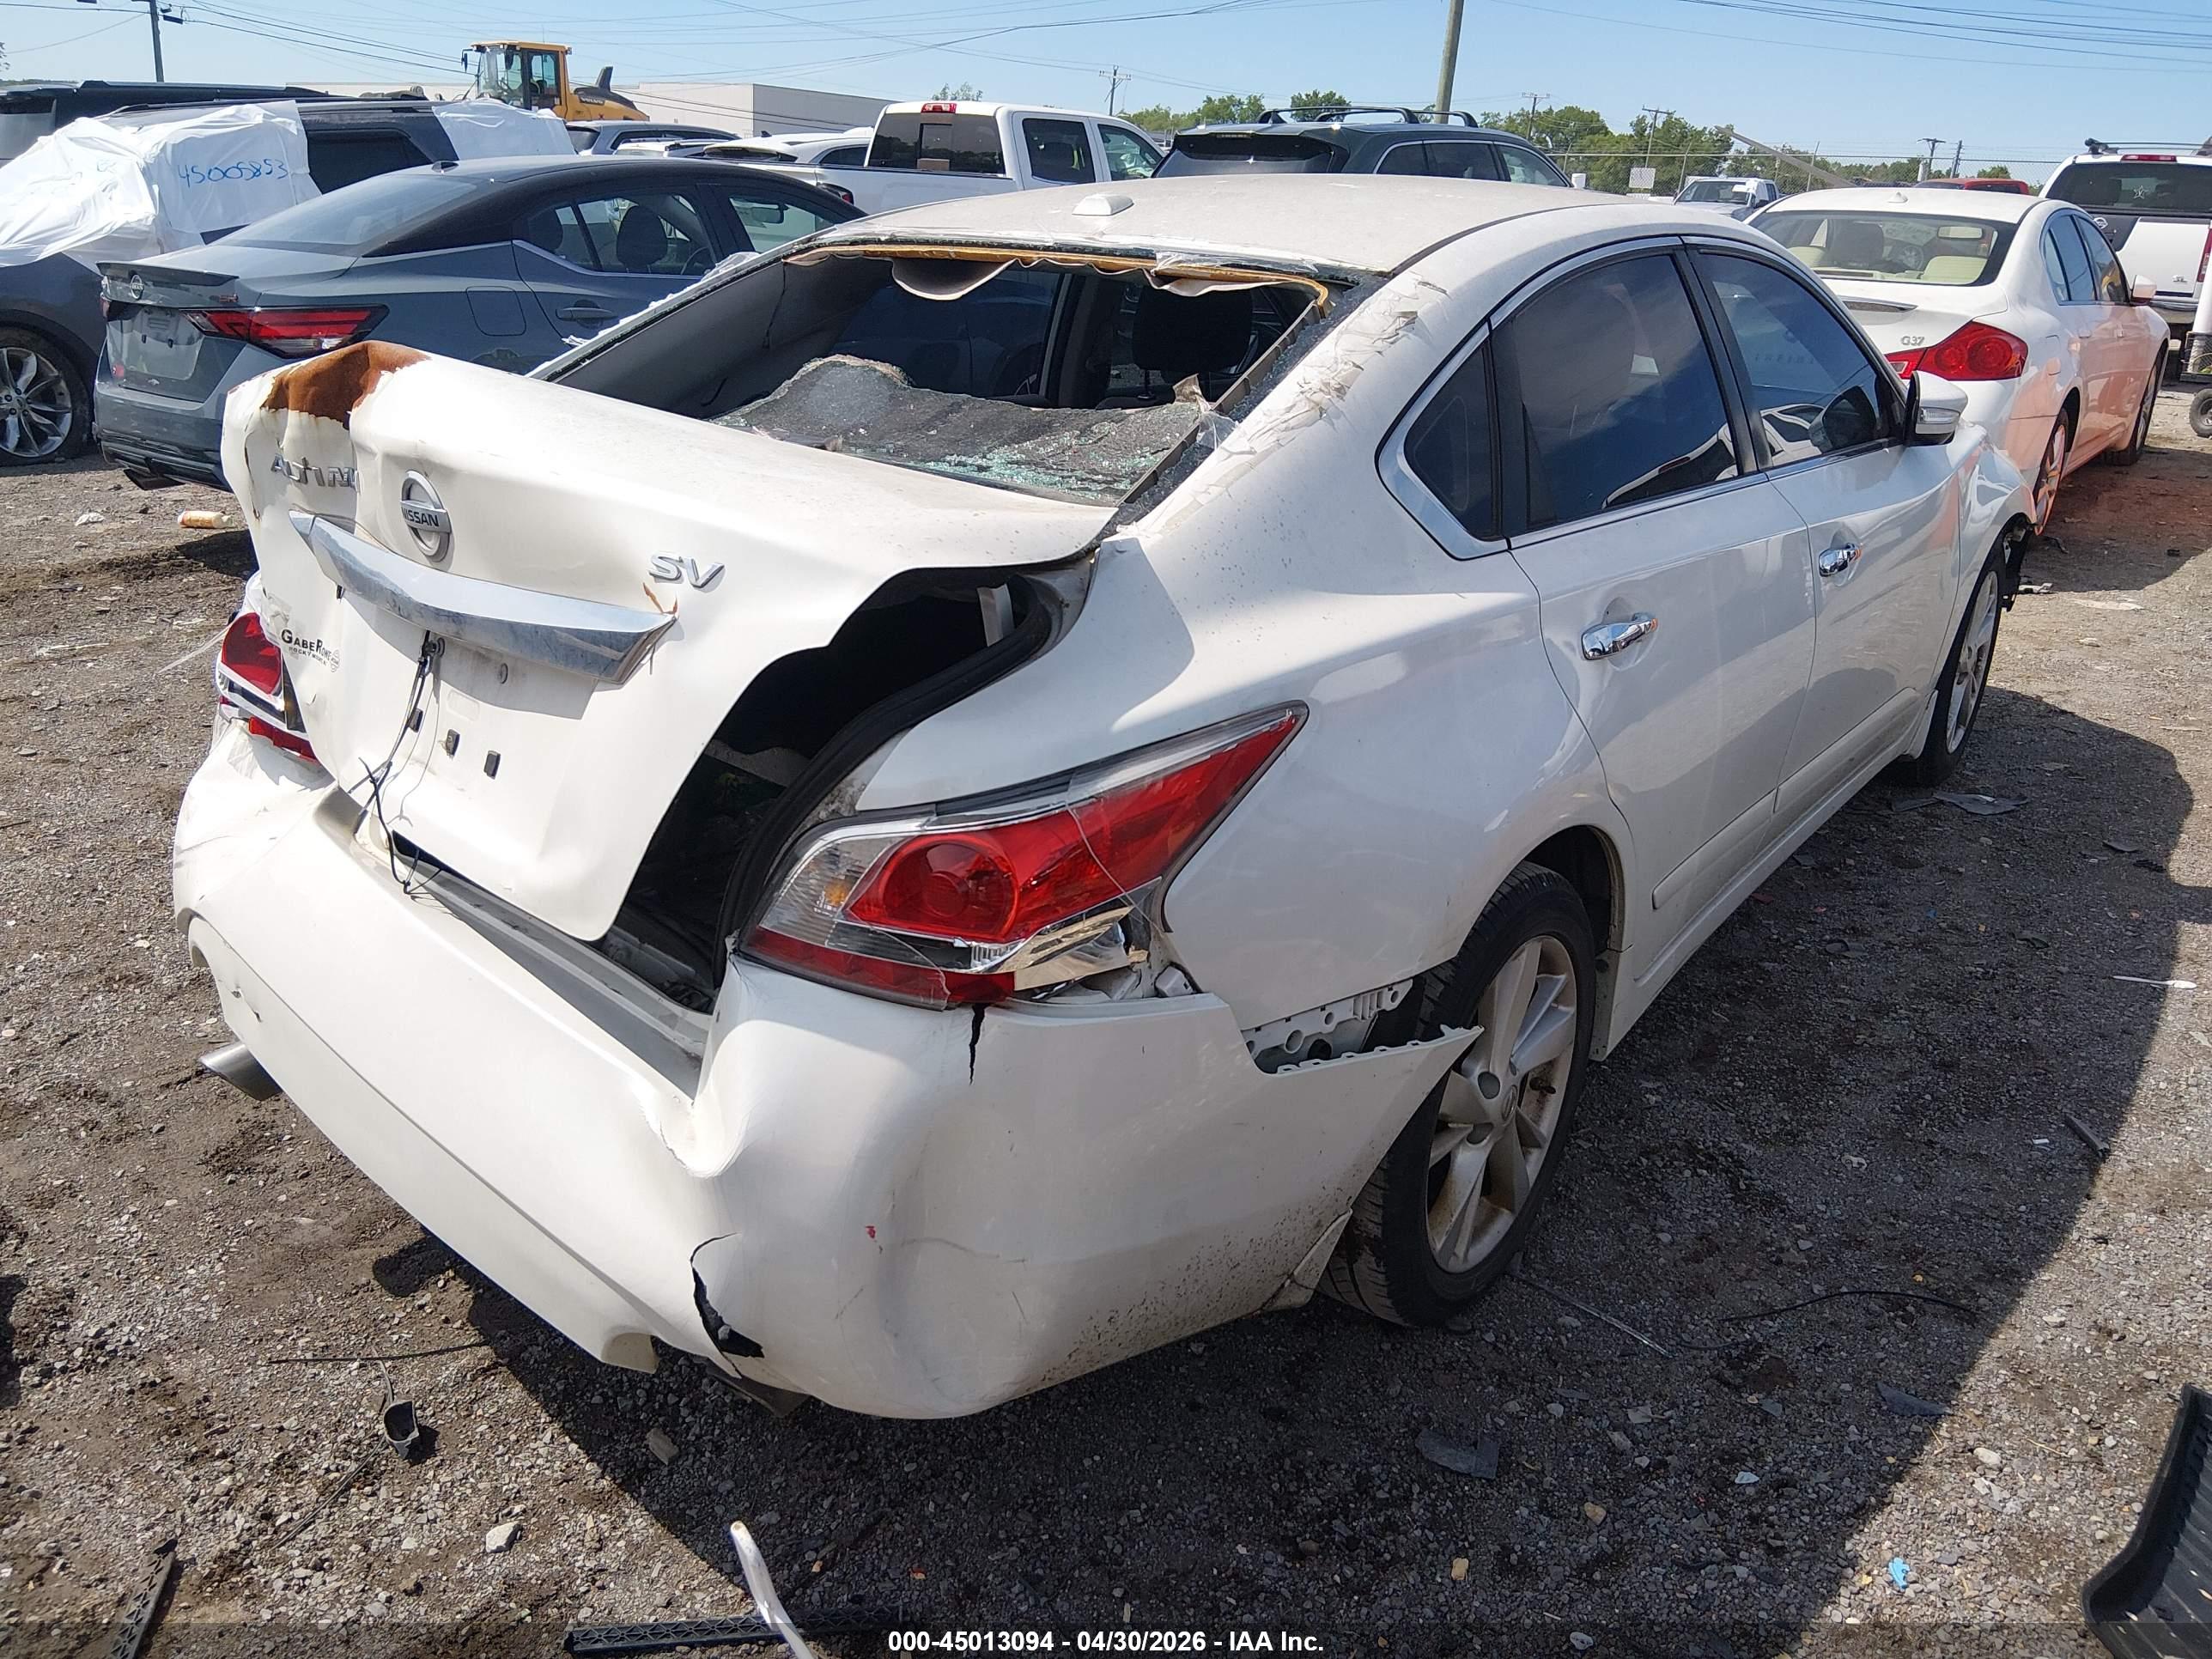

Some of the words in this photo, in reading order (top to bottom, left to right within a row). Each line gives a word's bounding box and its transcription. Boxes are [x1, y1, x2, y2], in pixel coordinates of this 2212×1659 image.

[178, 158, 289, 188] 45005853
[1900, 335, 1925, 346] G37
[401, 507, 440, 527] NISSAN
[647, 551, 726, 589] SV
